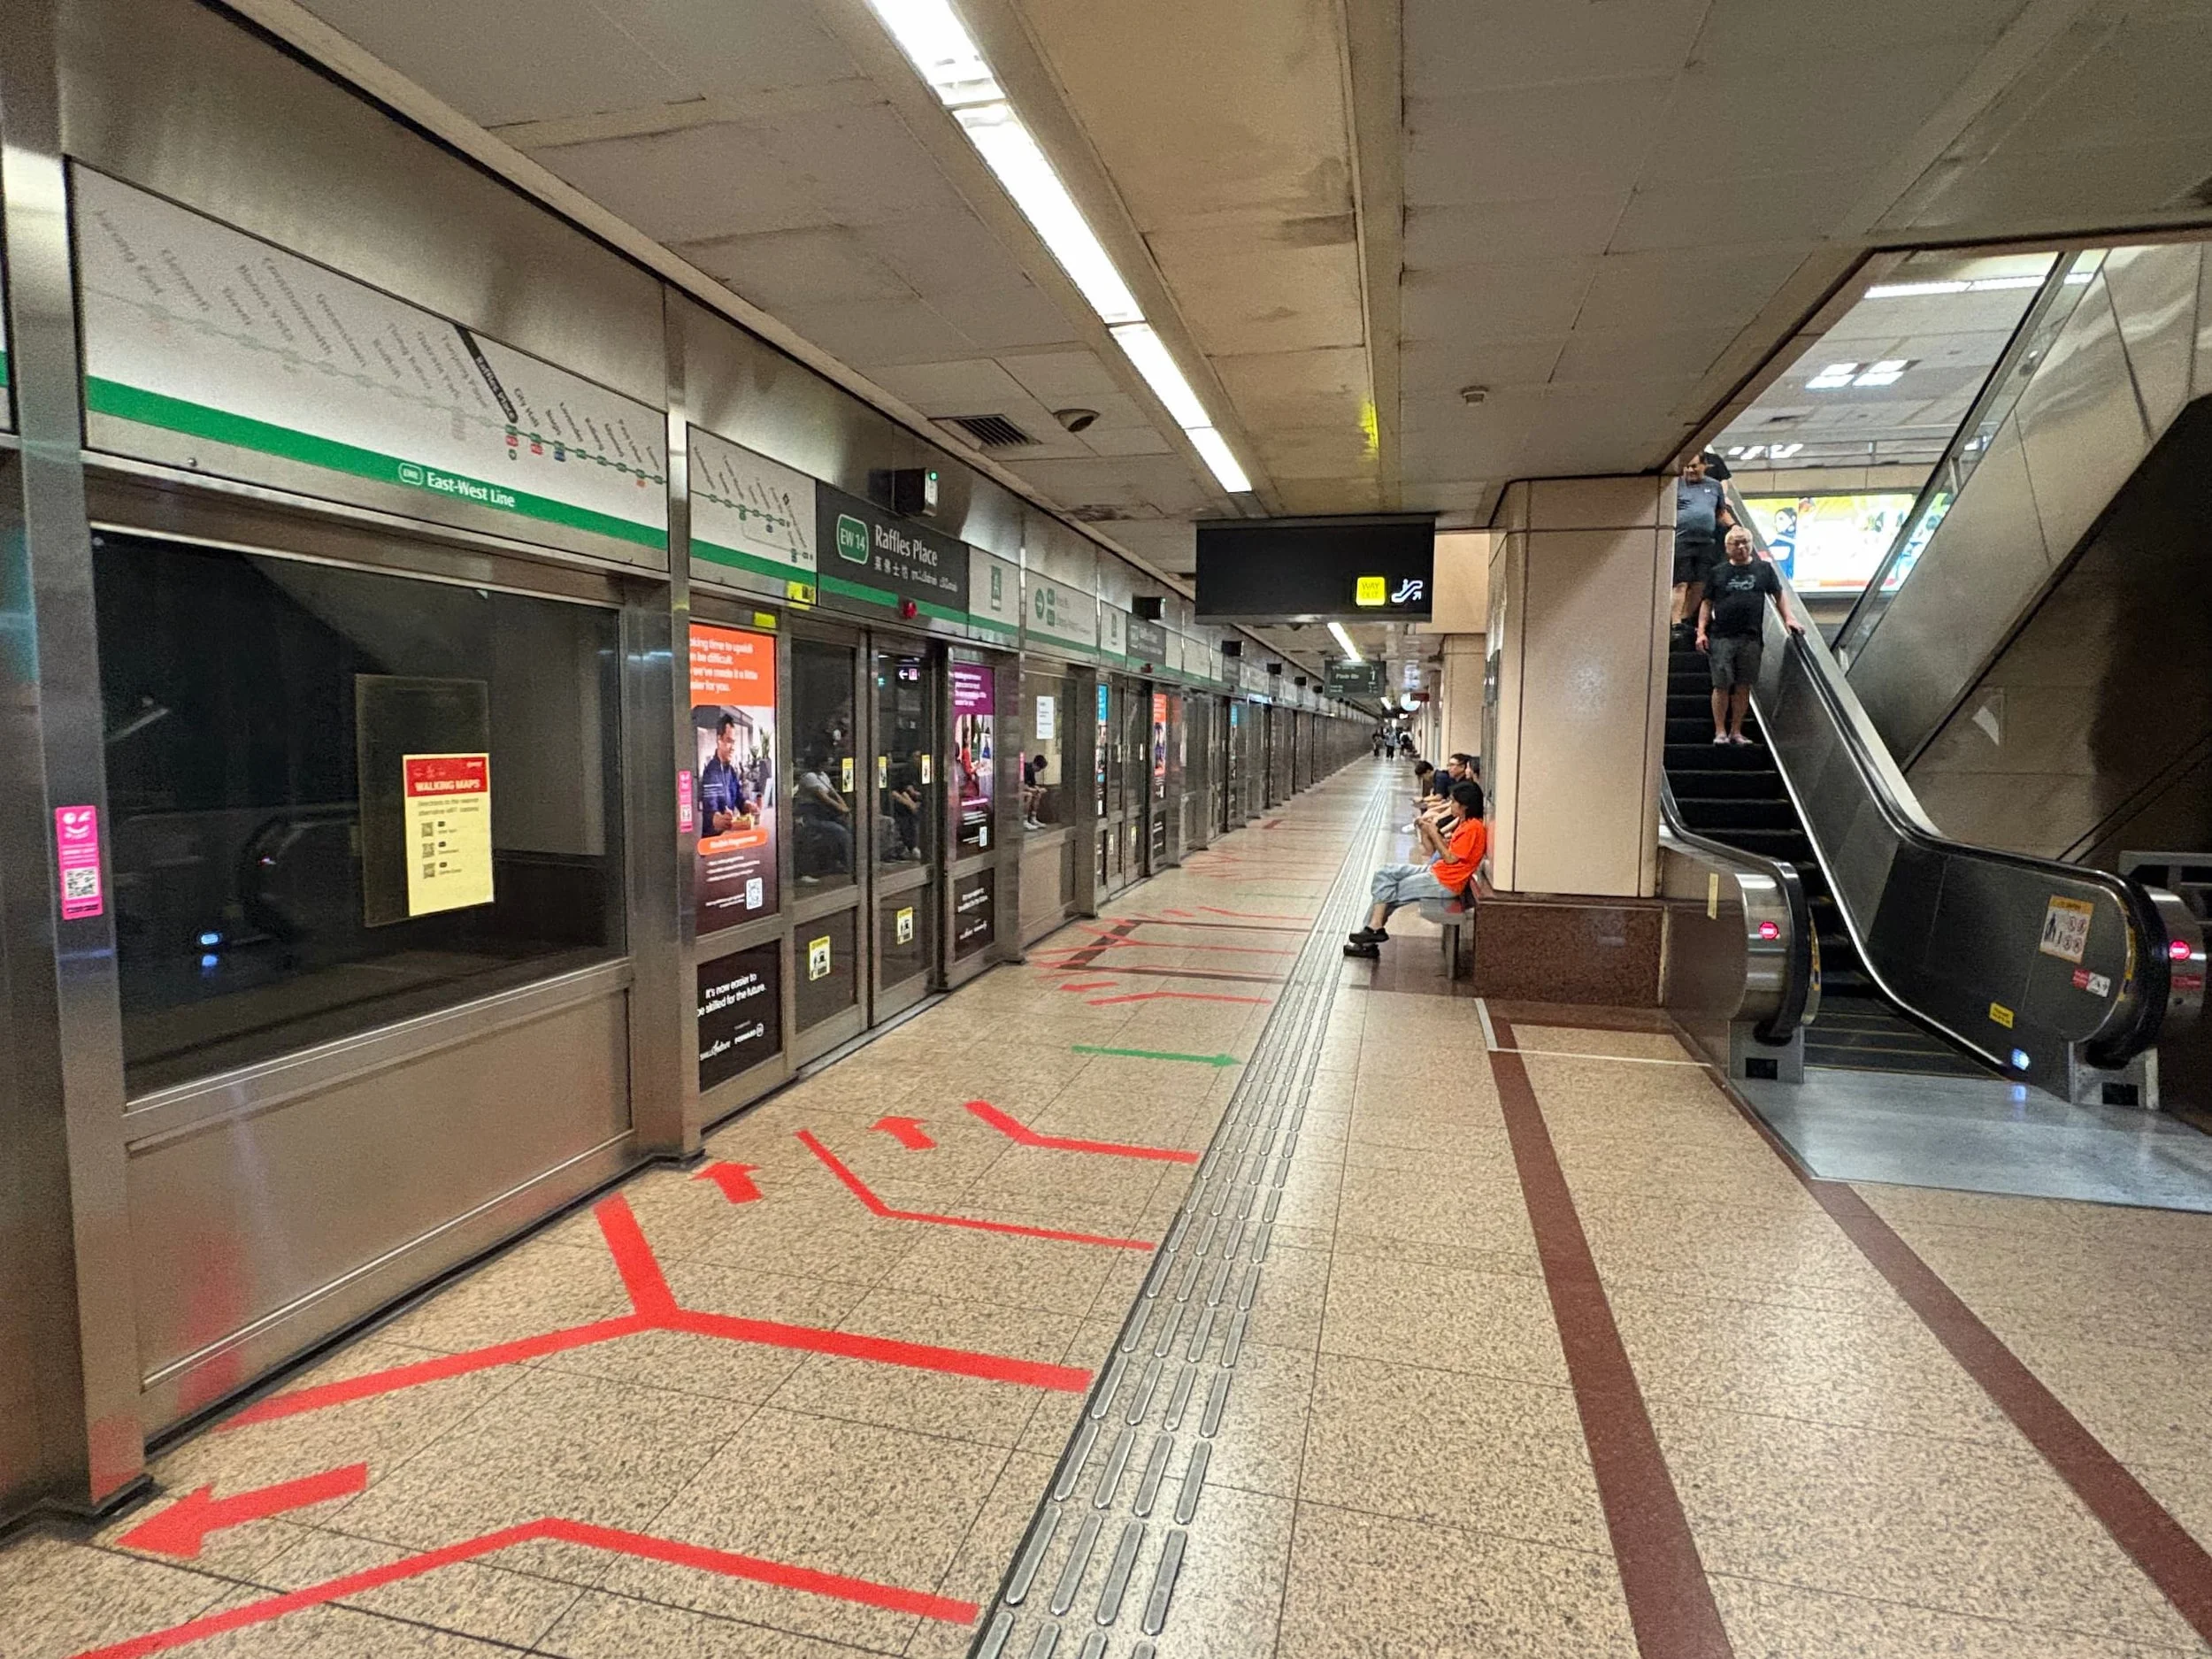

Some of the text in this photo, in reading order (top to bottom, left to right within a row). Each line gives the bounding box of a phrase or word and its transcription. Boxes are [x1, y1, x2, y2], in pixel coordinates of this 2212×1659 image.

[426, 472, 488, 501] East-West
[490, 488, 516, 508] Line
[840, 527, 866, 552] EW 14
[874, 524, 938, 567] Raffles Place
[414, 779, 481, 793] WALKING MAPS
[705, 988, 716, 999] It's
[716, 983, 730, 995] now
[749, 973, 757, 982] to
[726, 995, 736, 1005] for
[735, 990, 747, 1002] the
